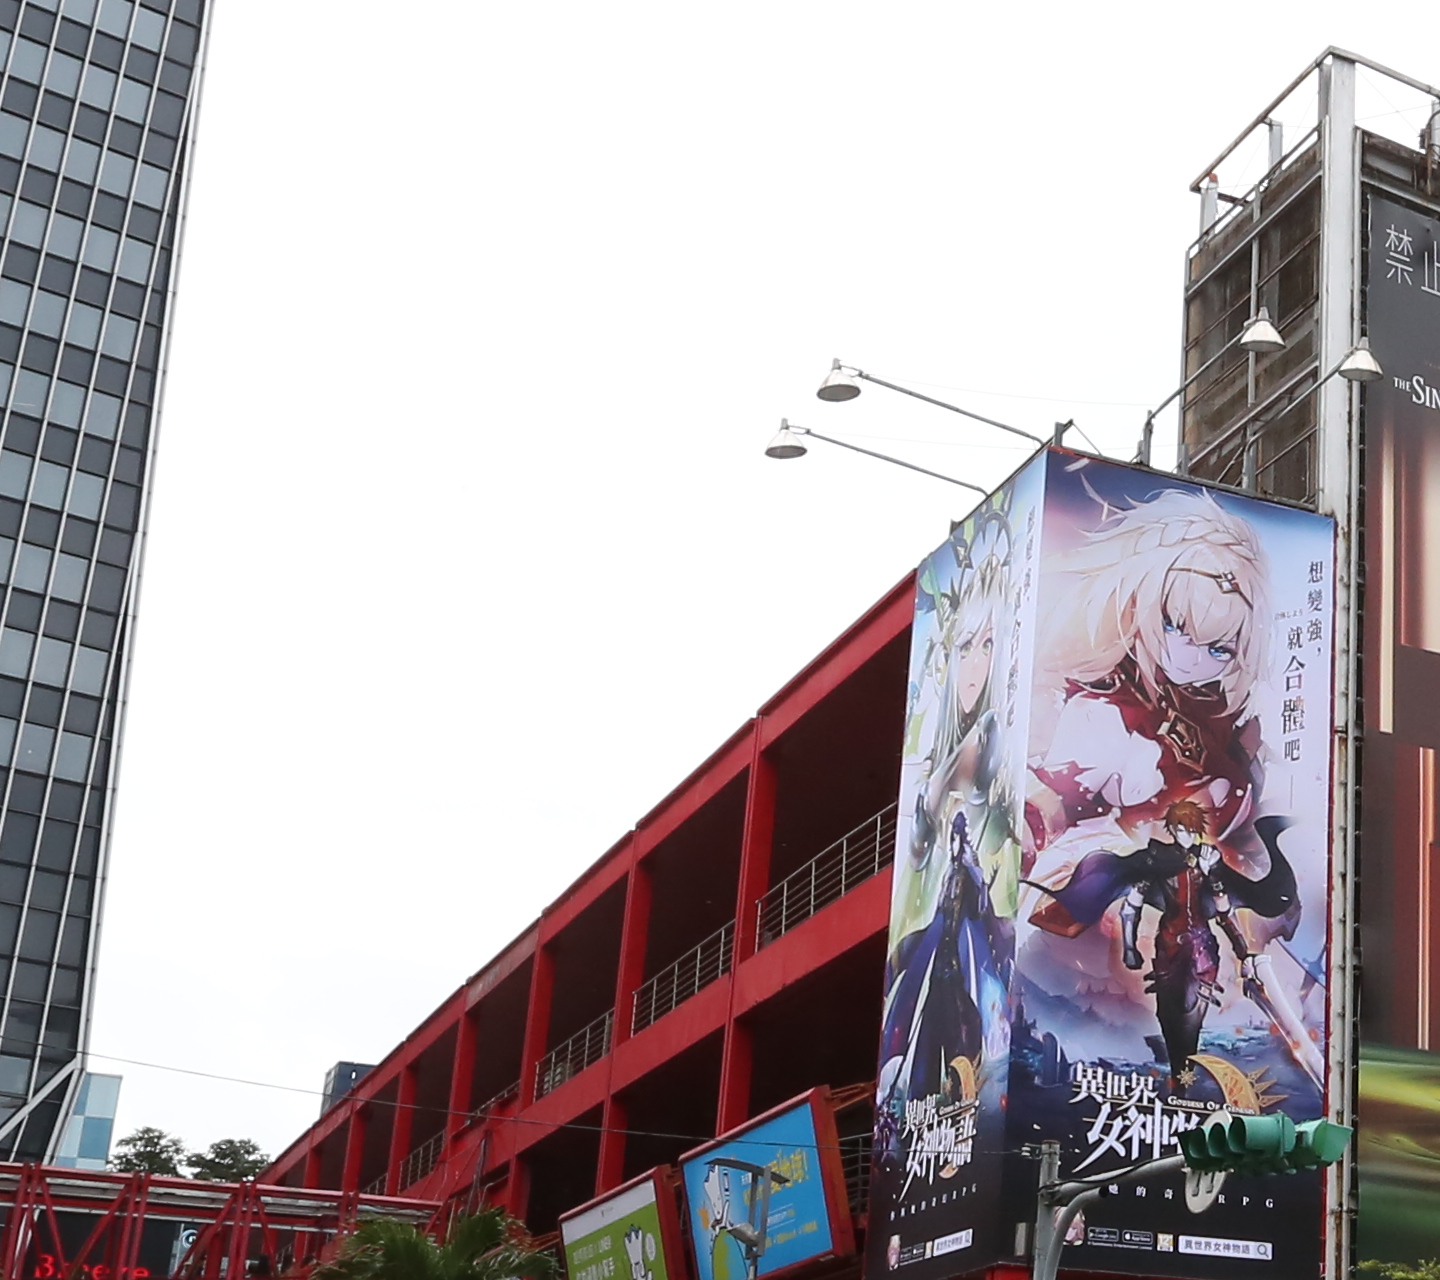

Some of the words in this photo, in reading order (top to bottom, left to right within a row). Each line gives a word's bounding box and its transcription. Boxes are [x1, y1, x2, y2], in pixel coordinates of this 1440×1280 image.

[1393, 376, 1411, 392] THE
[1068, 1062, 1159, 1110] 異世界
